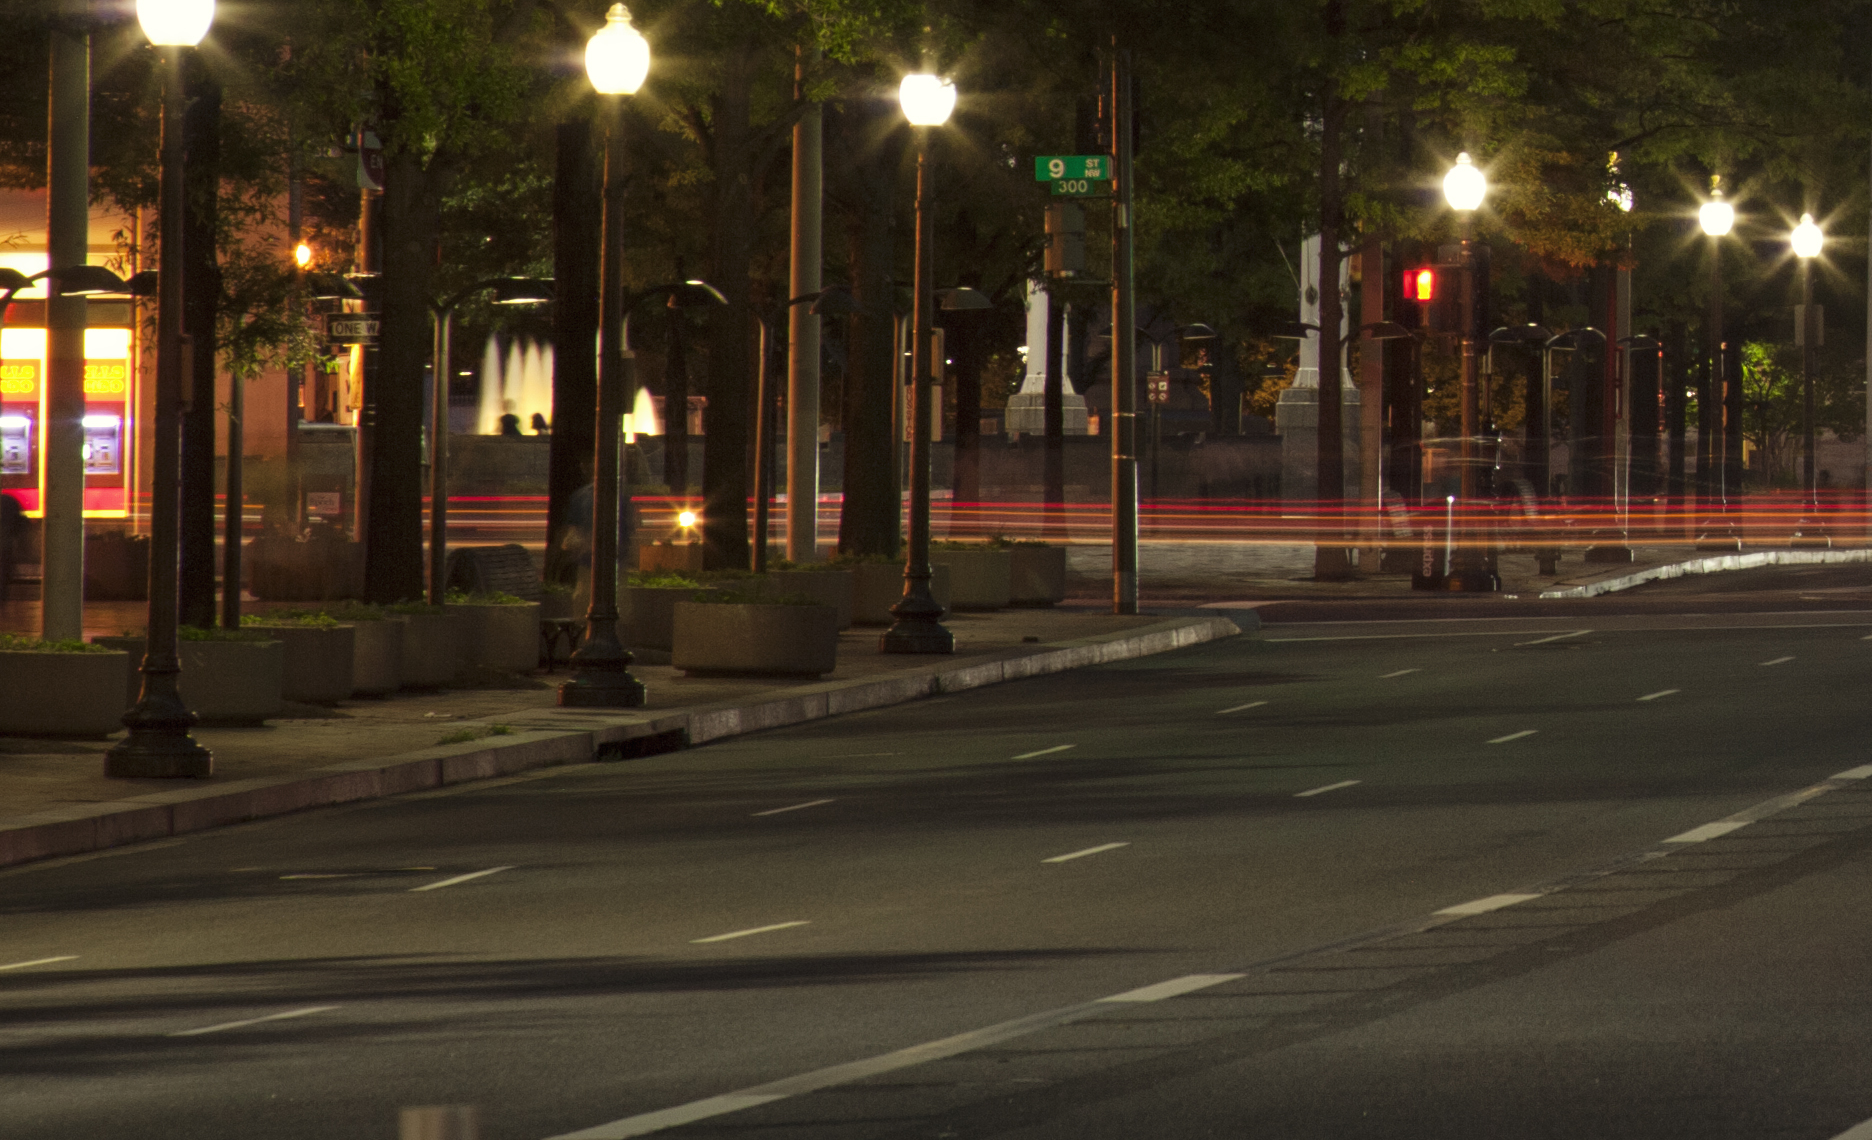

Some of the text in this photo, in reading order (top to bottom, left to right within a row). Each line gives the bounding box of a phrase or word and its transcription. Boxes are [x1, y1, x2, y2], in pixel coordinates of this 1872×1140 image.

[1049, 159, 1099, 178] 9 ST
[1085, 168, 1101, 177] NW
[1059, 180, 1088, 193] 300
[335, 323, 362, 335] ONE
